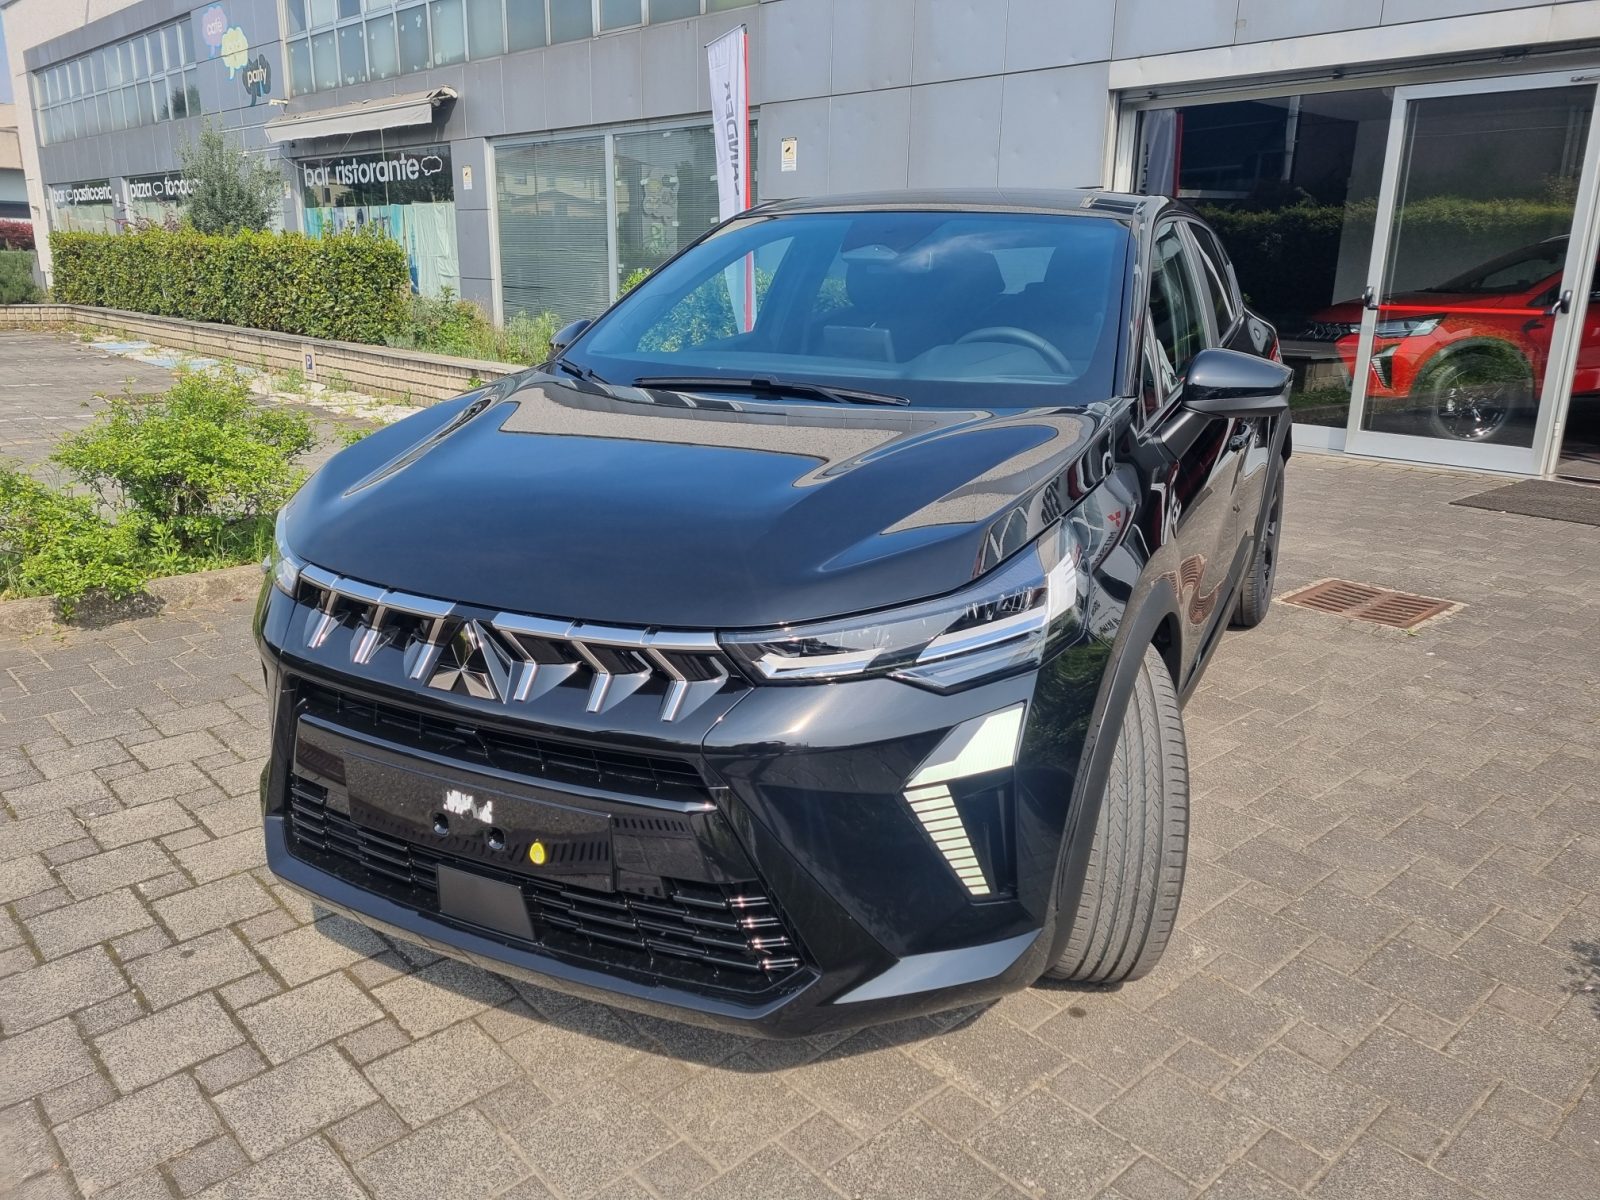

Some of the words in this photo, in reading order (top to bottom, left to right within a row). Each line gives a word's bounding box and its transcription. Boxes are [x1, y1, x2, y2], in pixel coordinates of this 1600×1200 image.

[247, 65, 267, 87] party
[304, 162, 330, 187] bar
[336, 152, 420, 185] ristorante
[53, 188, 65, 203] bar
[130, 179, 152, 201] pizza
